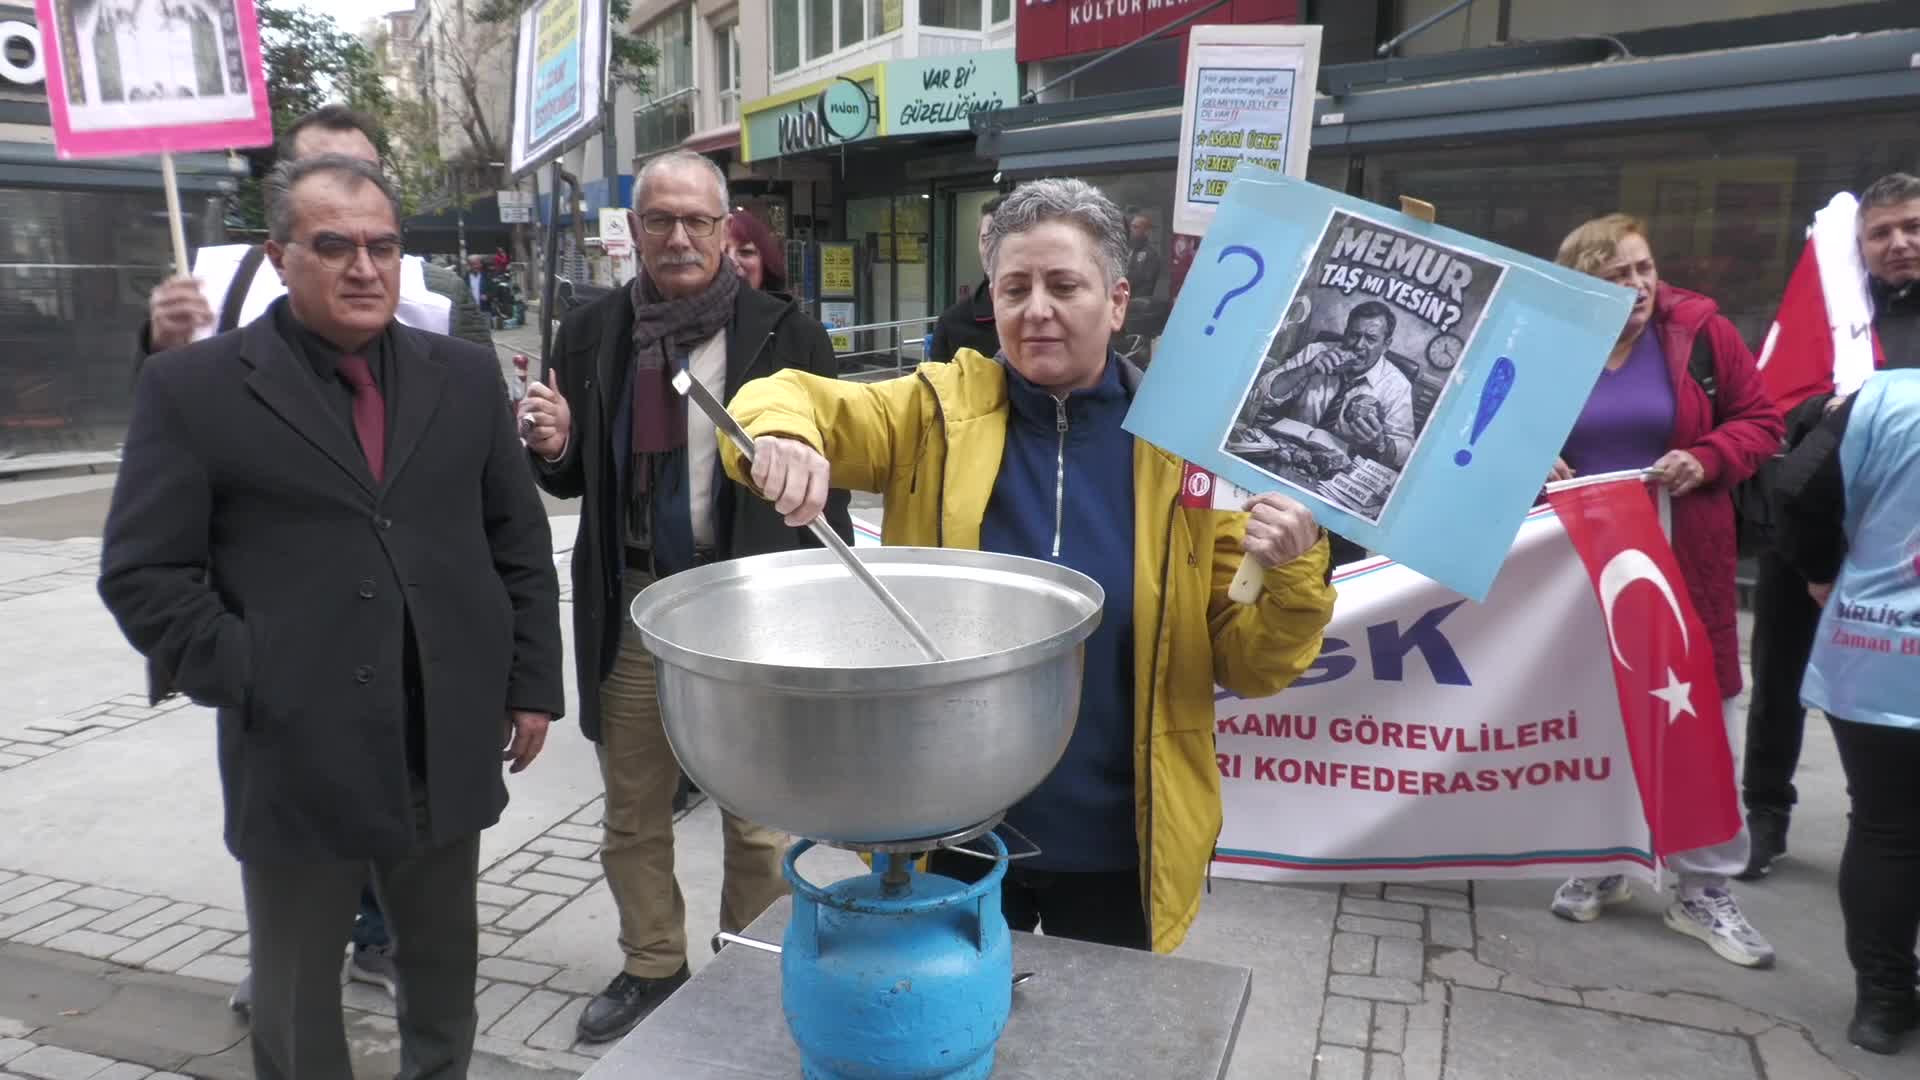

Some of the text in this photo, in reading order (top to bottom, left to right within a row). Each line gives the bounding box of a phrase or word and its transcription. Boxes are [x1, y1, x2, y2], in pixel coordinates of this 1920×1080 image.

[923, 66, 950, 90] VAR
[1267, 87, 1288, 96] ZAM
[1331, 227, 1473, 303] MEMUR
[1320, 264, 1462, 332] TAŞ MI YESİN?
[1217, 713, 1317, 741] KAMU
[1329, 710, 1579, 753] GÖREVLİLERİ
[1254, 756, 1612, 796] KONFEDERASYONU
